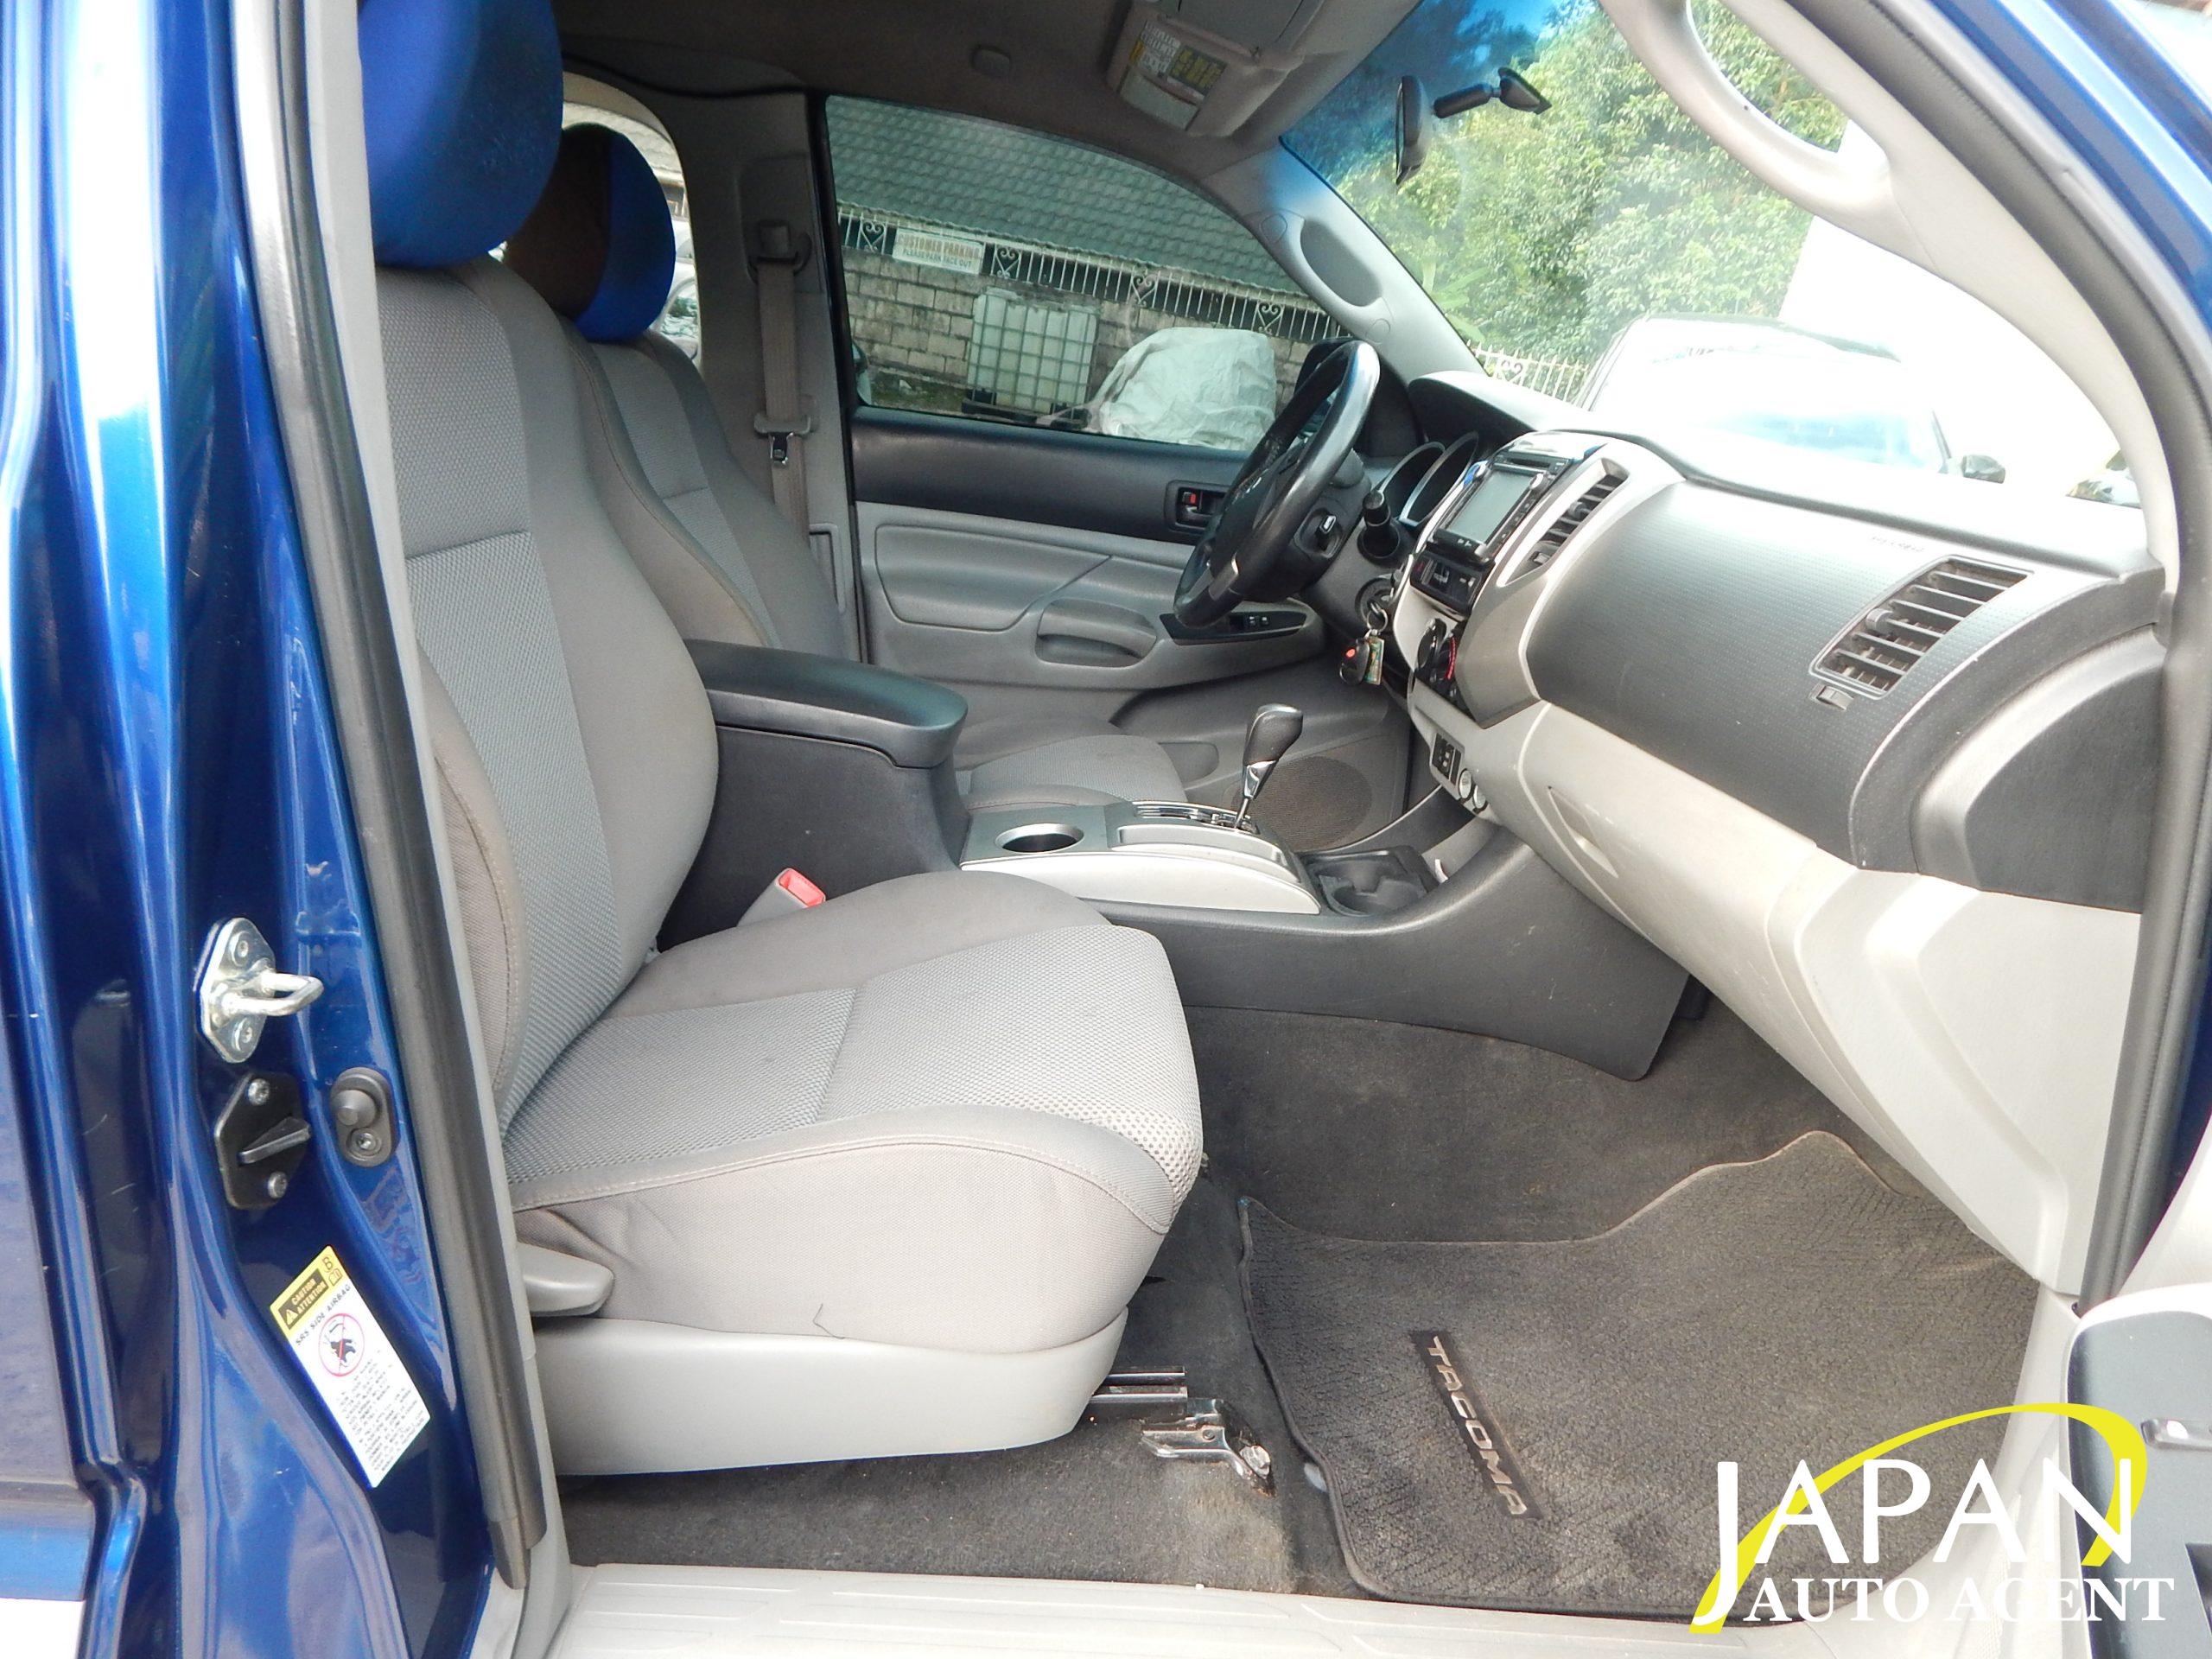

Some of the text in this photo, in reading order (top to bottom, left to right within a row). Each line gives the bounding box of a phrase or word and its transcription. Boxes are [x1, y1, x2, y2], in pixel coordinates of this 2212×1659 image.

[291, 1278, 317, 1306] CAUTION
[296, 1281, 327, 1314] ATTENTION
[296, 1284, 351, 1345] SRS SIDE AIRBAG
[1427, 1336, 1528, 1515] TACOMA
